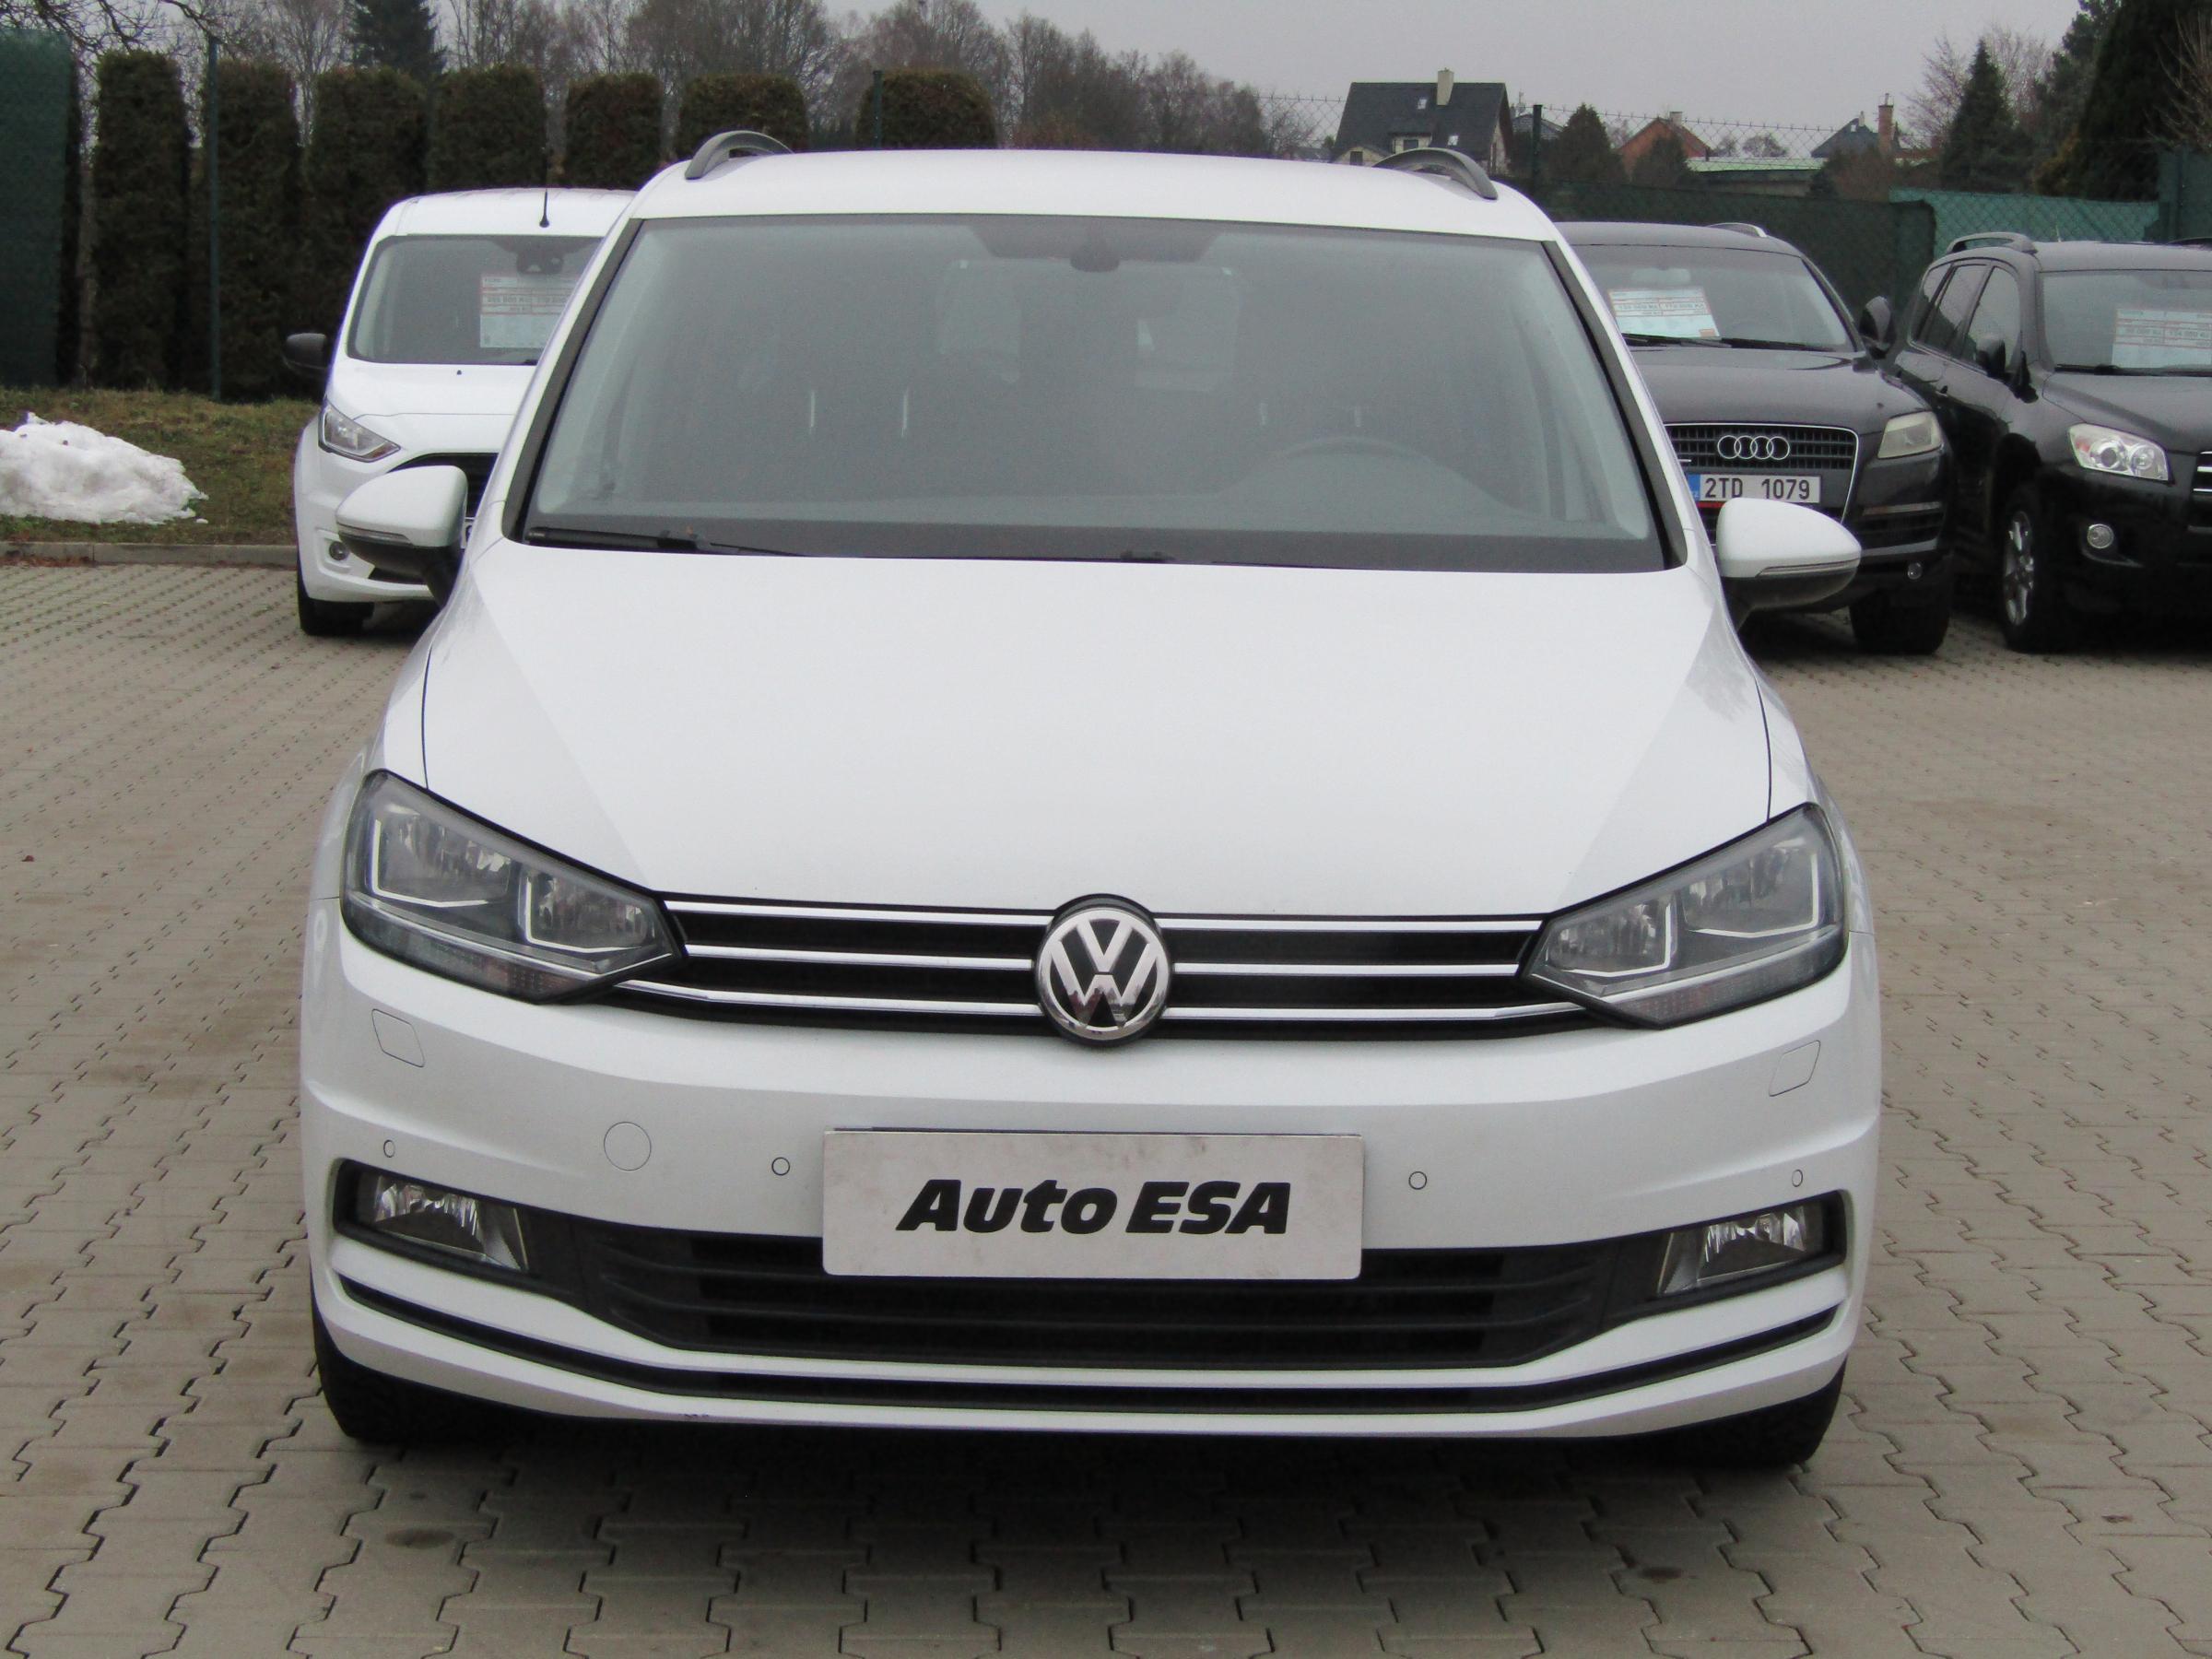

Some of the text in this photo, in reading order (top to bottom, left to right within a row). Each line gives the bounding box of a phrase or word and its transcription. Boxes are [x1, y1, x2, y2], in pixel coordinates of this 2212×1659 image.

[1705, 477, 1810, 500] 2TD 1079
[1043, 912, 1164, 1033] VW
[895, 1179, 1291, 1235] Auto ESA
